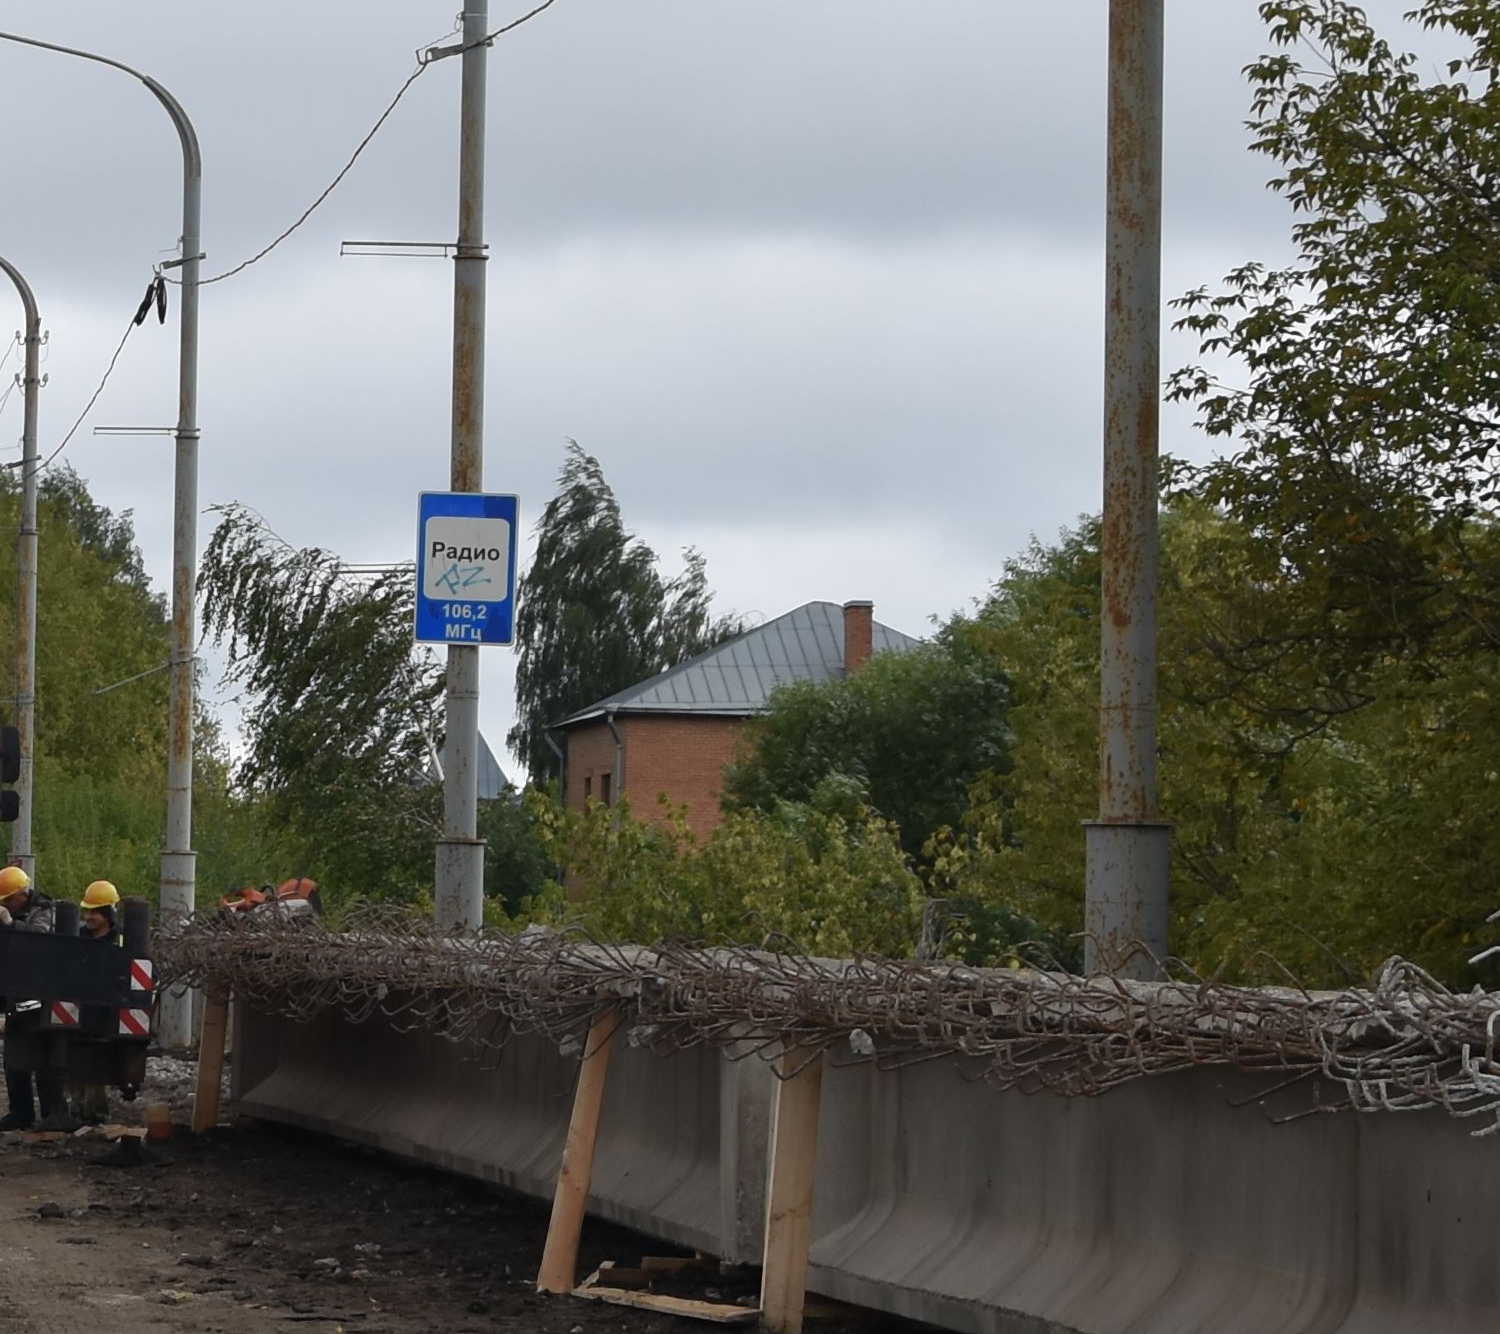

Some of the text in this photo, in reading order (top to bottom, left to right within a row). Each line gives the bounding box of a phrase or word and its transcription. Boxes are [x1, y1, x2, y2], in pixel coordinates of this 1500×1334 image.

[432, 541, 500, 563] Радио
[443, 603, 487, 621] 106,2
[445, 624, 482, 641] МГц
